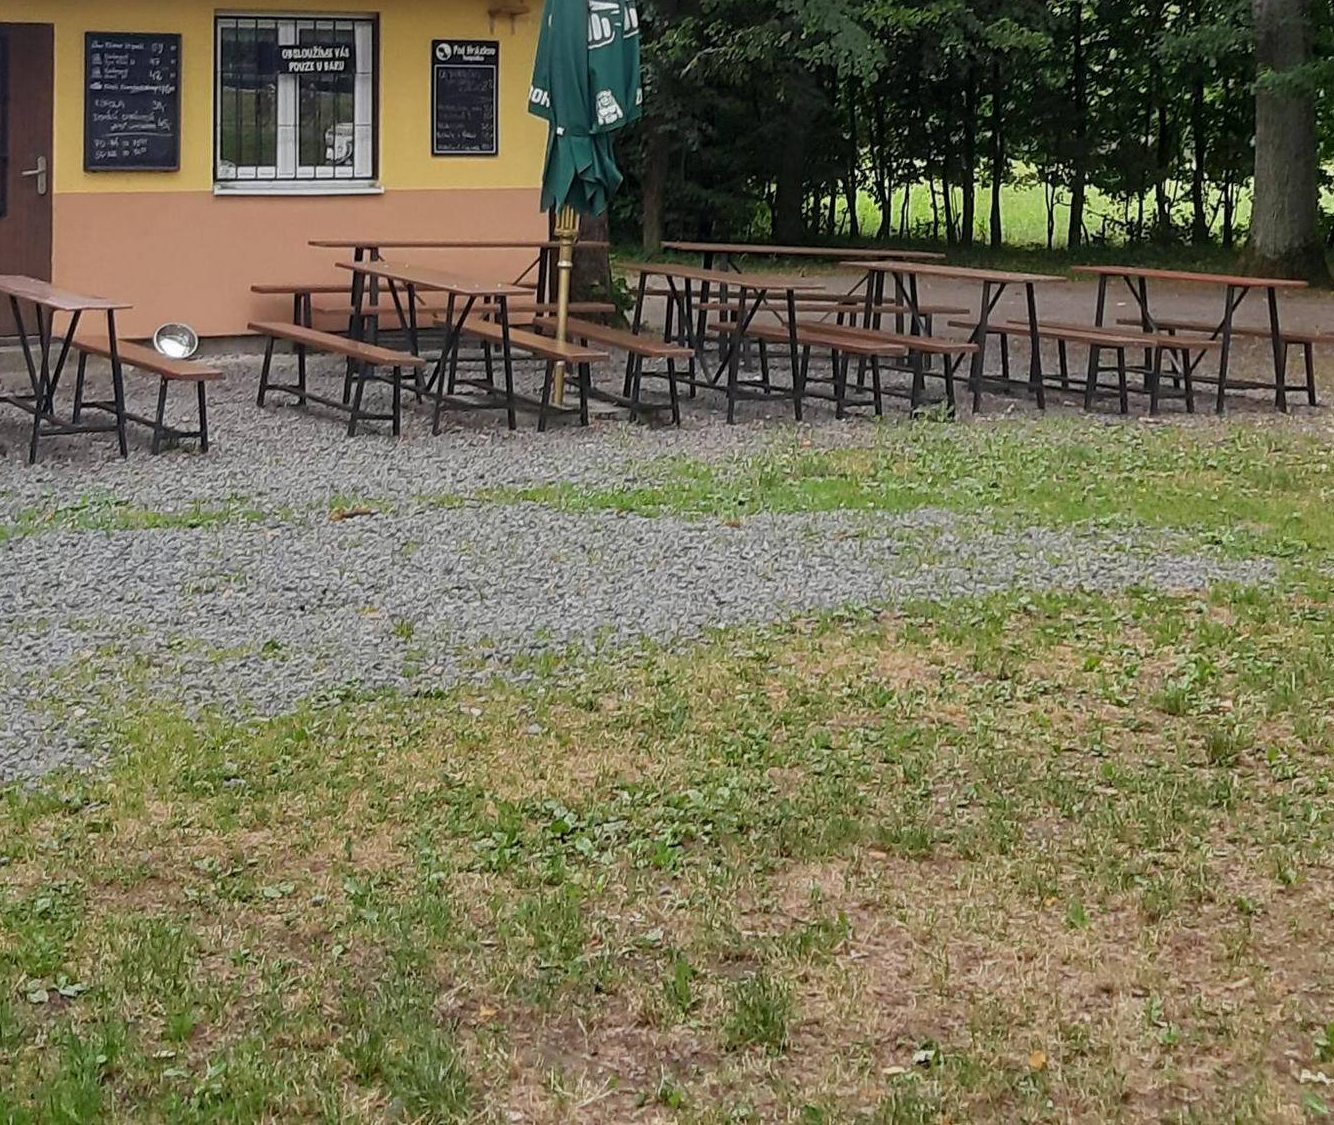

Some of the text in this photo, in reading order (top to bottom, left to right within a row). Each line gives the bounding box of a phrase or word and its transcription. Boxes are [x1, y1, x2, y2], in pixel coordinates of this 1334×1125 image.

[334, 45, 350, 58] VÁS
[288, 60, 345, 72] POUZE U BARU
